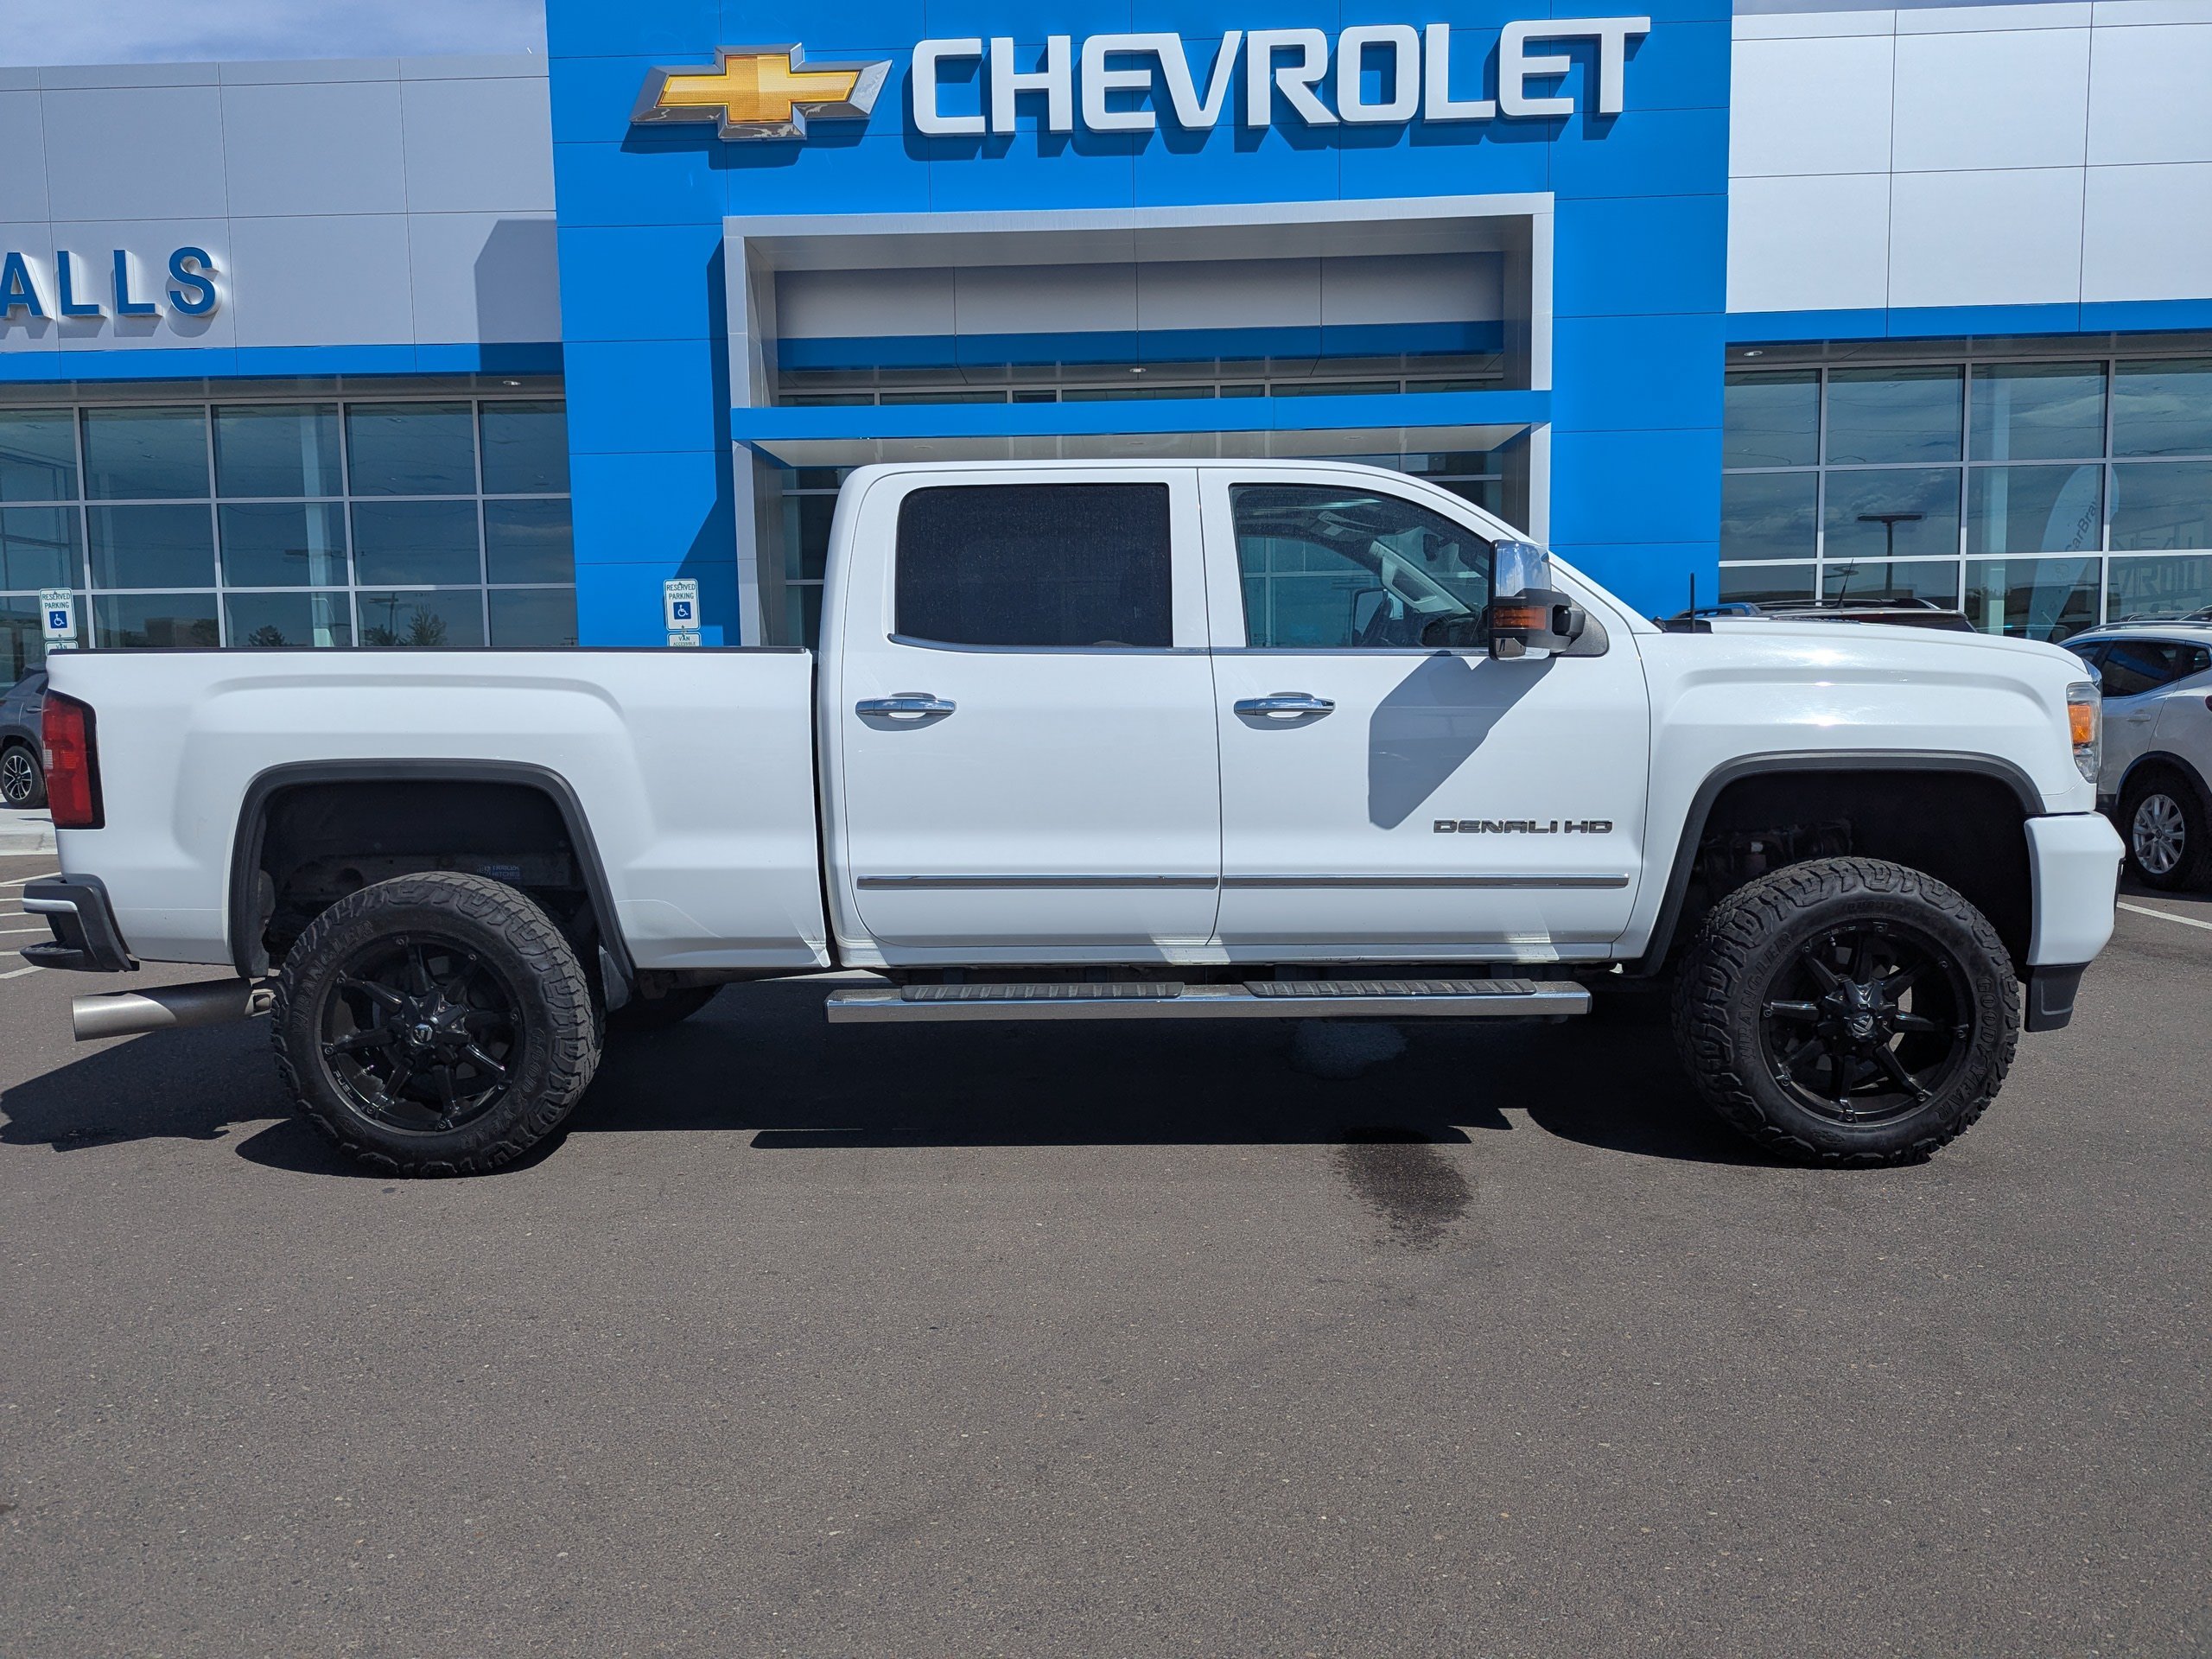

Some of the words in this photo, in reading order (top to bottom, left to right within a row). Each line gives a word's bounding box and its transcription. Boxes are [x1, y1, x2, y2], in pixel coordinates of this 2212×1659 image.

[912, 16, 1651, 137] CHEVROLET
[0, 245, 219, 319] ALLS
[1433, 819, 1559, 834] DENALI
[1564, 819, 1613, 834] HD
[333, 1070, 353, 1099] FUEL
[1936, 976, 1998, 1122] GOODYEAR
